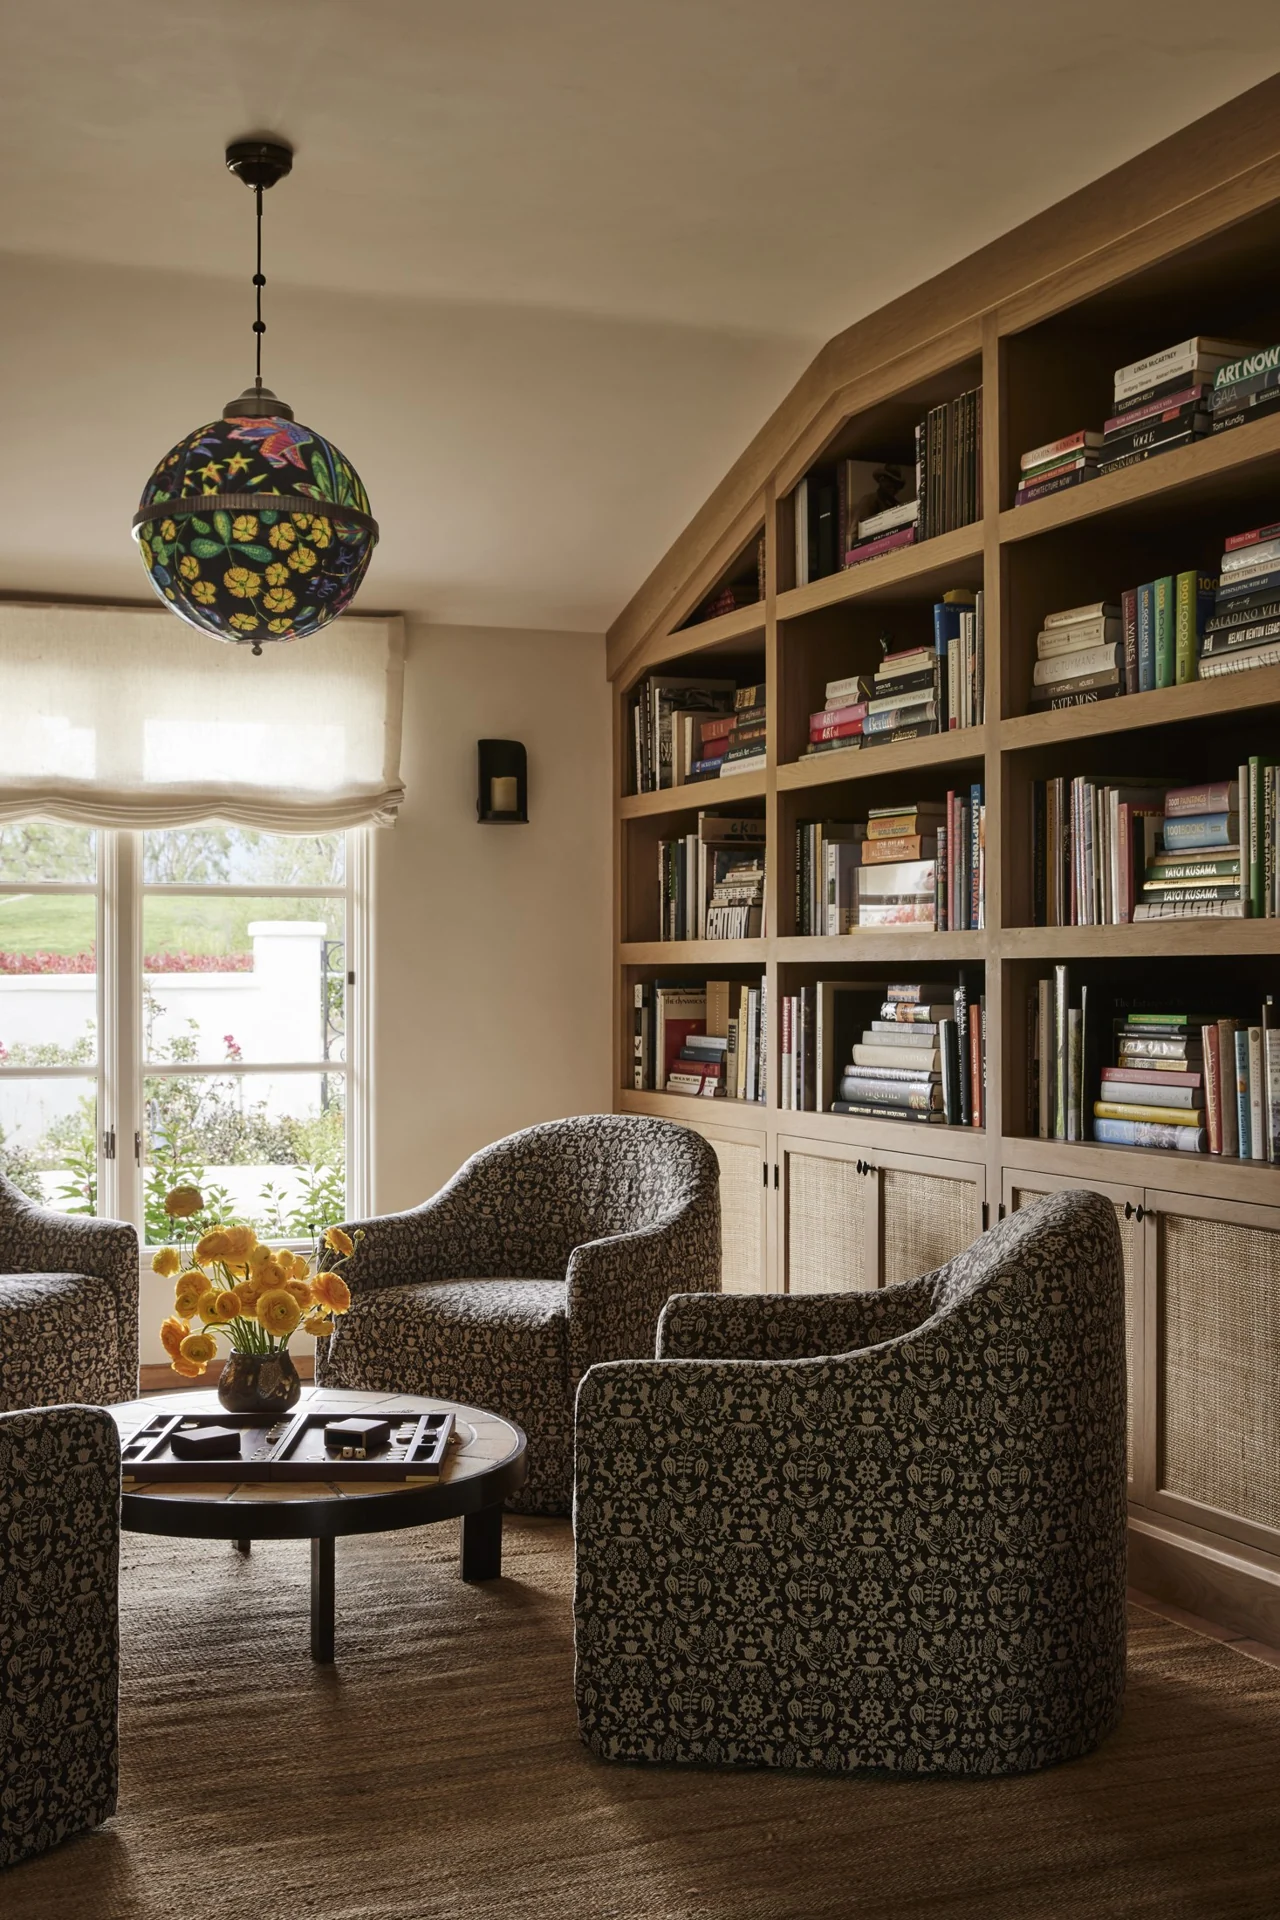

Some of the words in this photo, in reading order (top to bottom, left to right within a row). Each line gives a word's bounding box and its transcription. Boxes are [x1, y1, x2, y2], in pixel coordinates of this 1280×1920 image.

[1133, 363, 1149, 374] LINDA
[1216, 361, 1242, 387] ART
[1211, 386, 1238, 408] GAIA
[1212, 421, 1225, 431] Tom
[1027, 479, 1060, 498] ARCHITECTURE
[1210, 608, 1259, 629] SALADINO
[1128, 622, 1136, 662] WINES
[1075, 691, 1099, 706] MOSS
[972, 798, 980, 868] HAMPTONS
[1164, 865, 1185, 878] YAYOI
[1185, 863, 1217, 877] KUSAMA
[972, 869, 980, 921] PRIVATE
[1163, 890, 1184, 902] YAYOI
[1184, 888, 1219, 901] KUSAMA
[706, 906, 748, 940] CENTURY
[783, 1002, 791, 1053] Furniture
